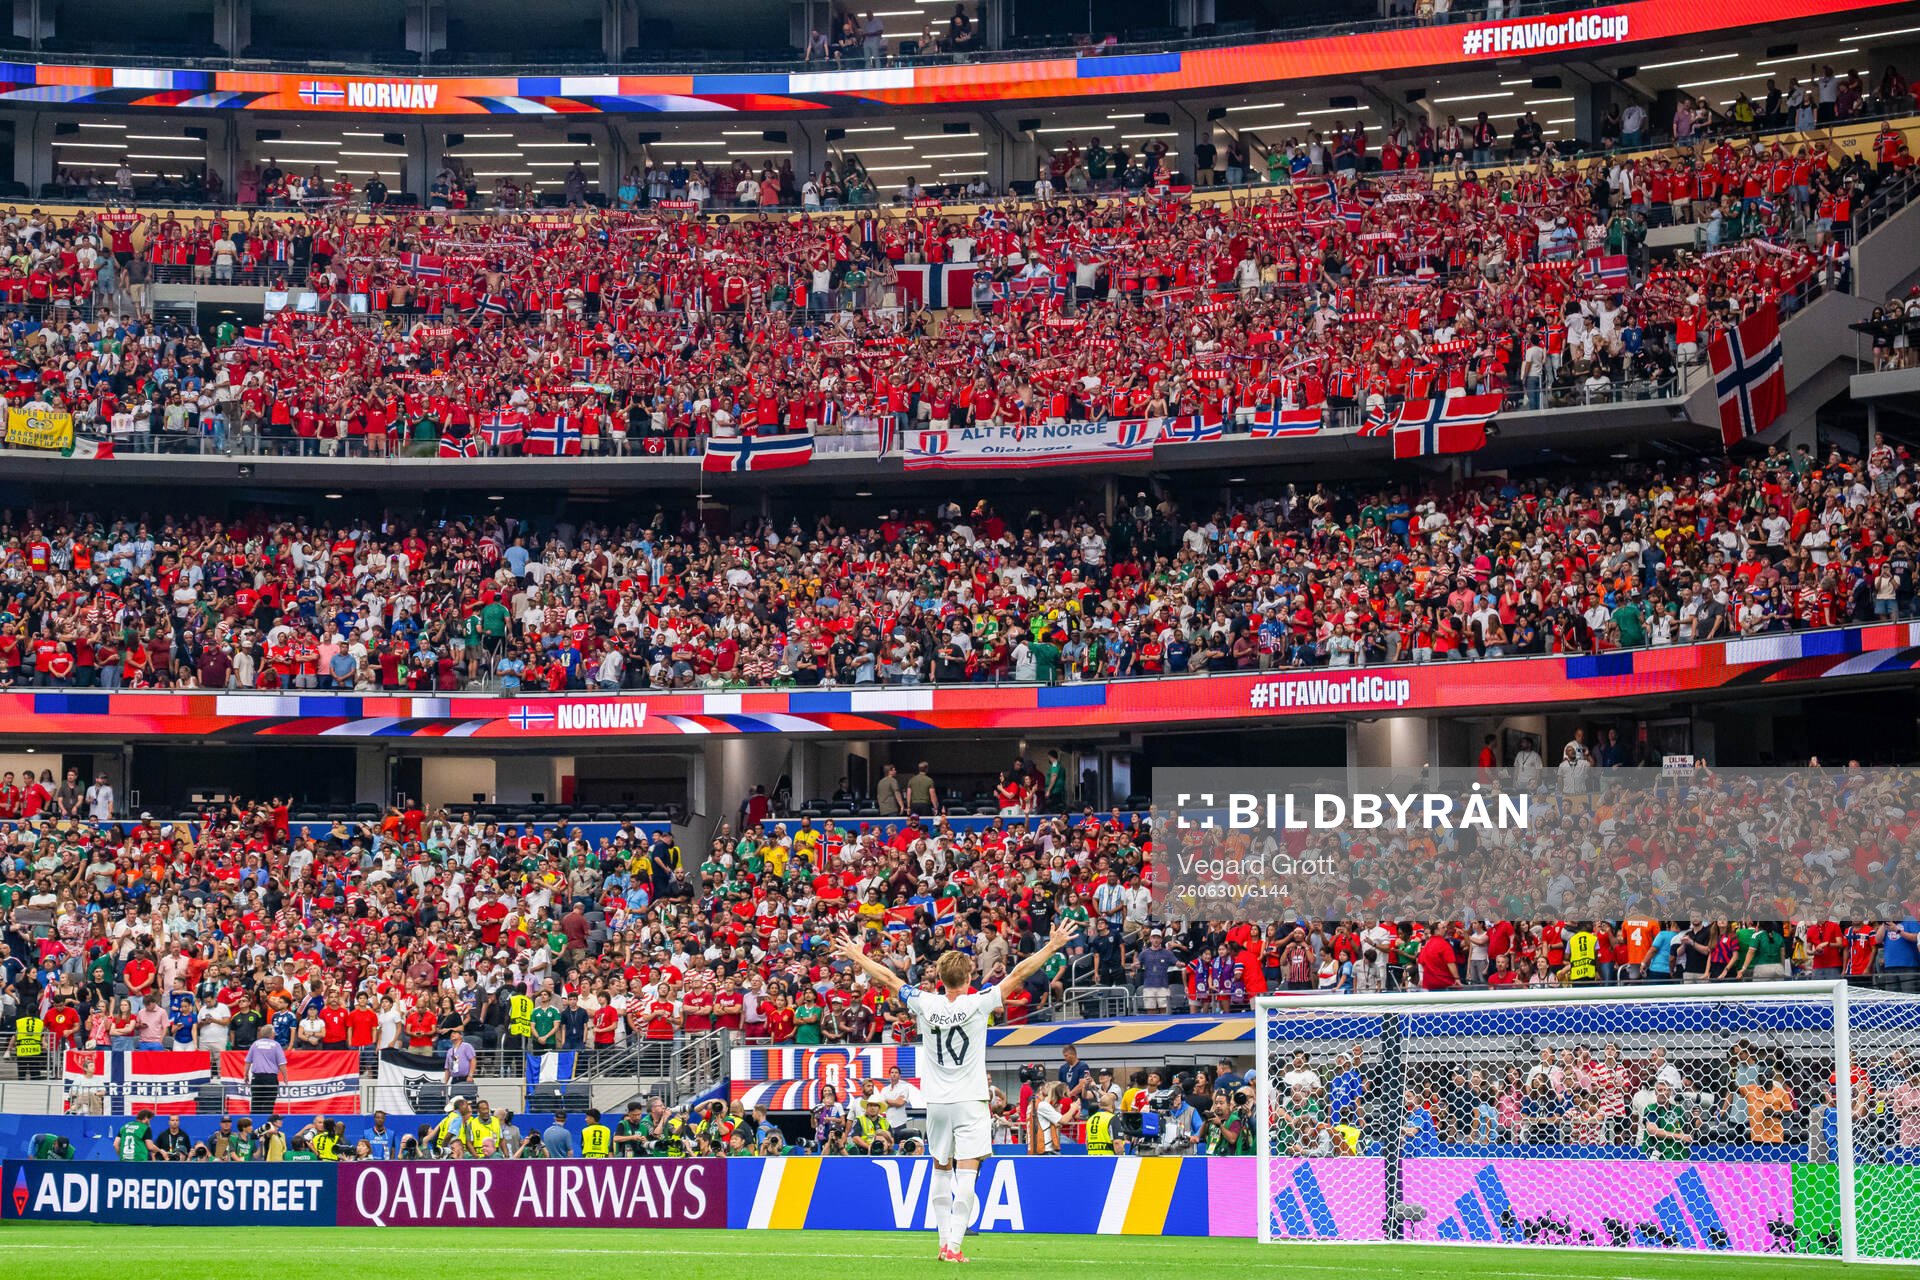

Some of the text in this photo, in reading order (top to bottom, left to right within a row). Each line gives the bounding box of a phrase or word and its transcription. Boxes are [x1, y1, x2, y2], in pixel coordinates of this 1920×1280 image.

[1463, 14, 1629, 54] #FIFAWorldCup
[348, 82, 438, 108] NORWAY
[961, 423, 1108, 440] ALT FOR NORGE
[1250, 676, 1410, 709] #FIFAWorldCup
[557, 703, 647, 730] NORWAY
[1631, 928, 1642, 946] 4
[931, 1024, 970, 1066] 10
[109, 1081, 189, 1096] RØMMEN
[33, 1172, 324, 1213] ADI PREDICTSTREET
[355, 1164, 707, 1227] QATAR AIRWAYS
